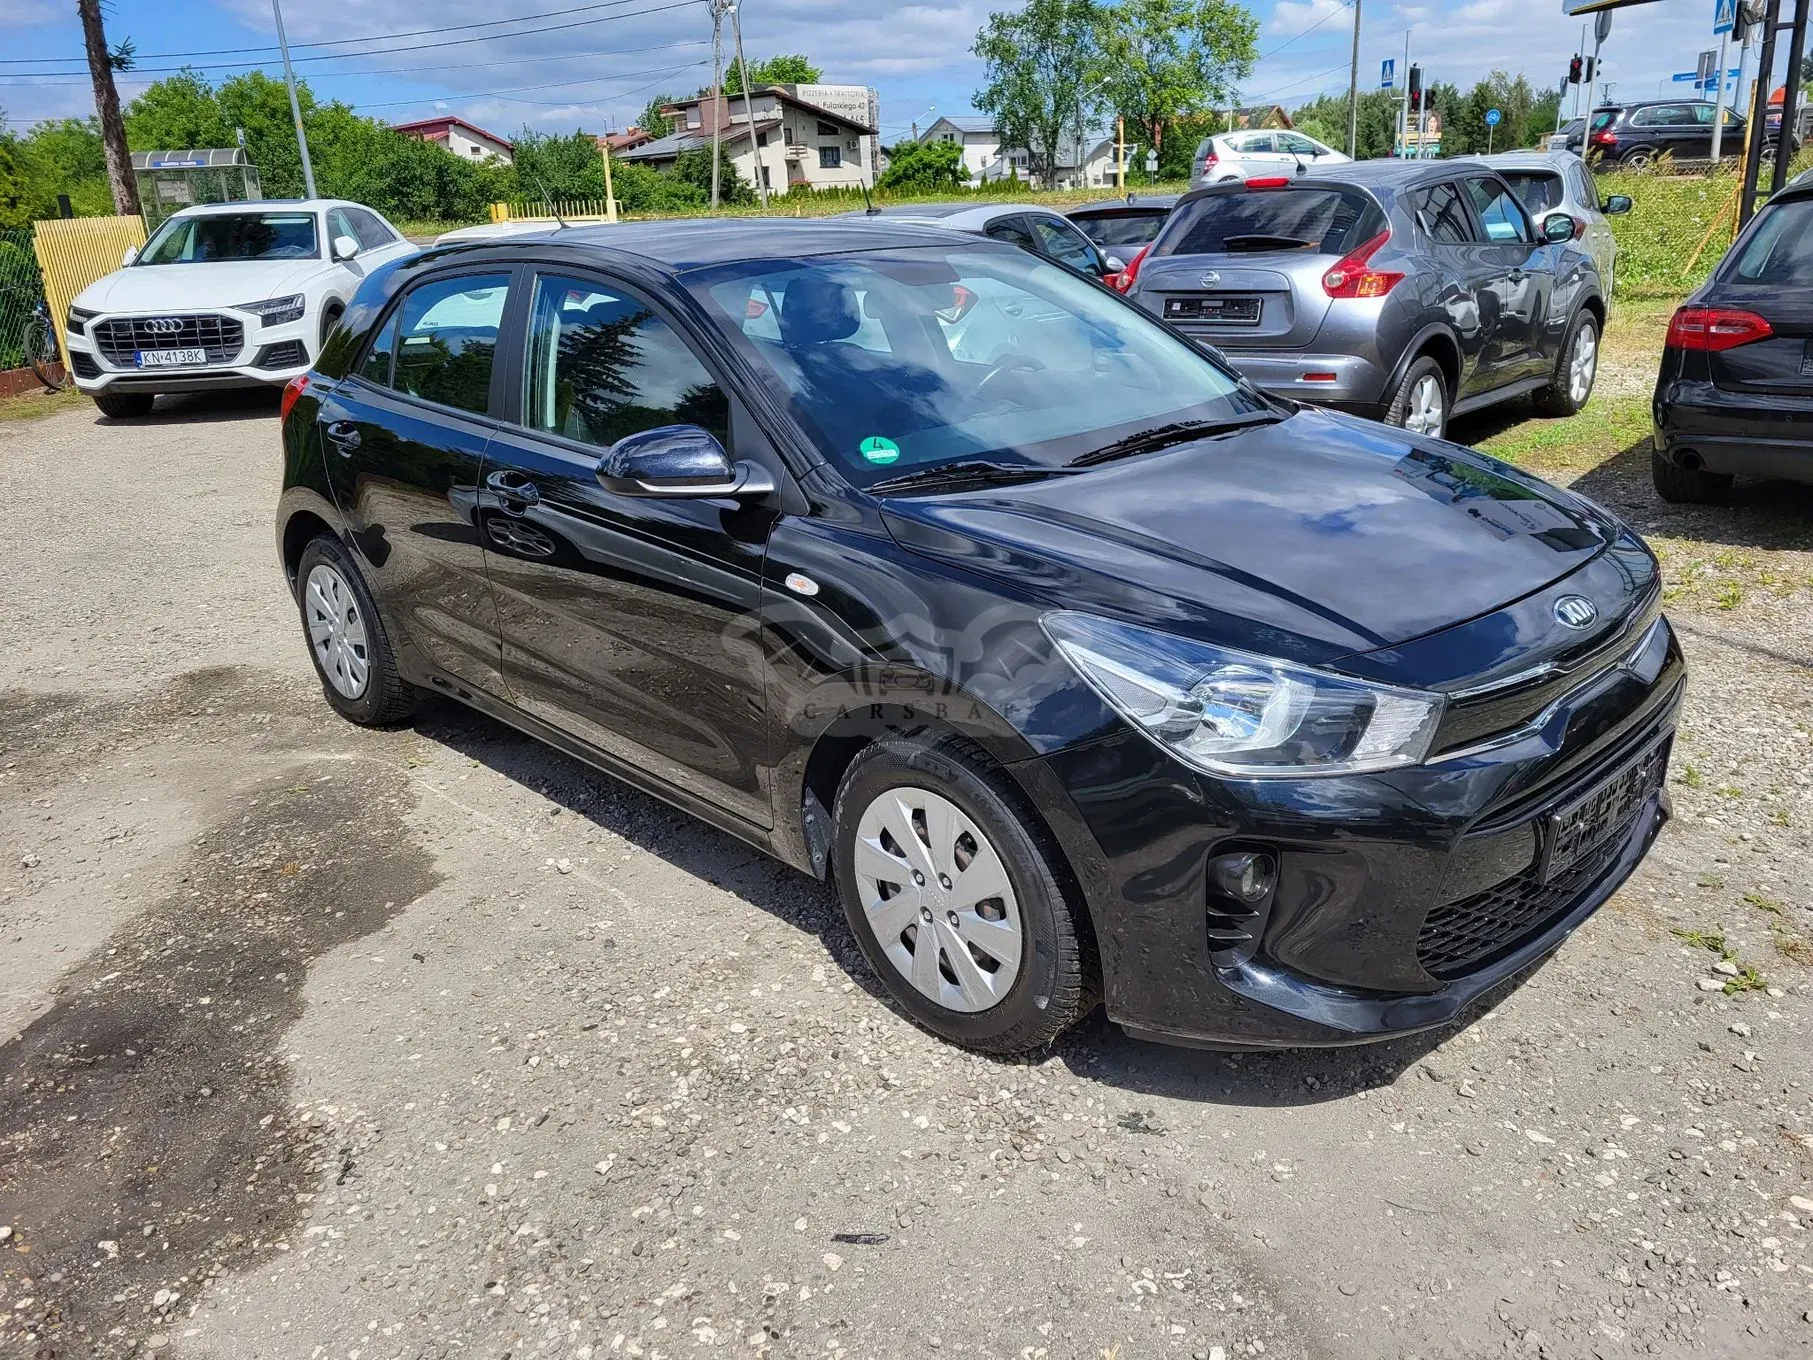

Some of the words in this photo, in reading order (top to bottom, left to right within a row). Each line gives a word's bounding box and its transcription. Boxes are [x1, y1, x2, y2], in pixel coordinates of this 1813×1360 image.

[857, 102, 865, 110] 42
[143, 352, 161, 364] KN
[164, 350, 202, 363] 4138K
[873, 437, 884, 450] 4
[1559, 598, 1595, 624] KIA
